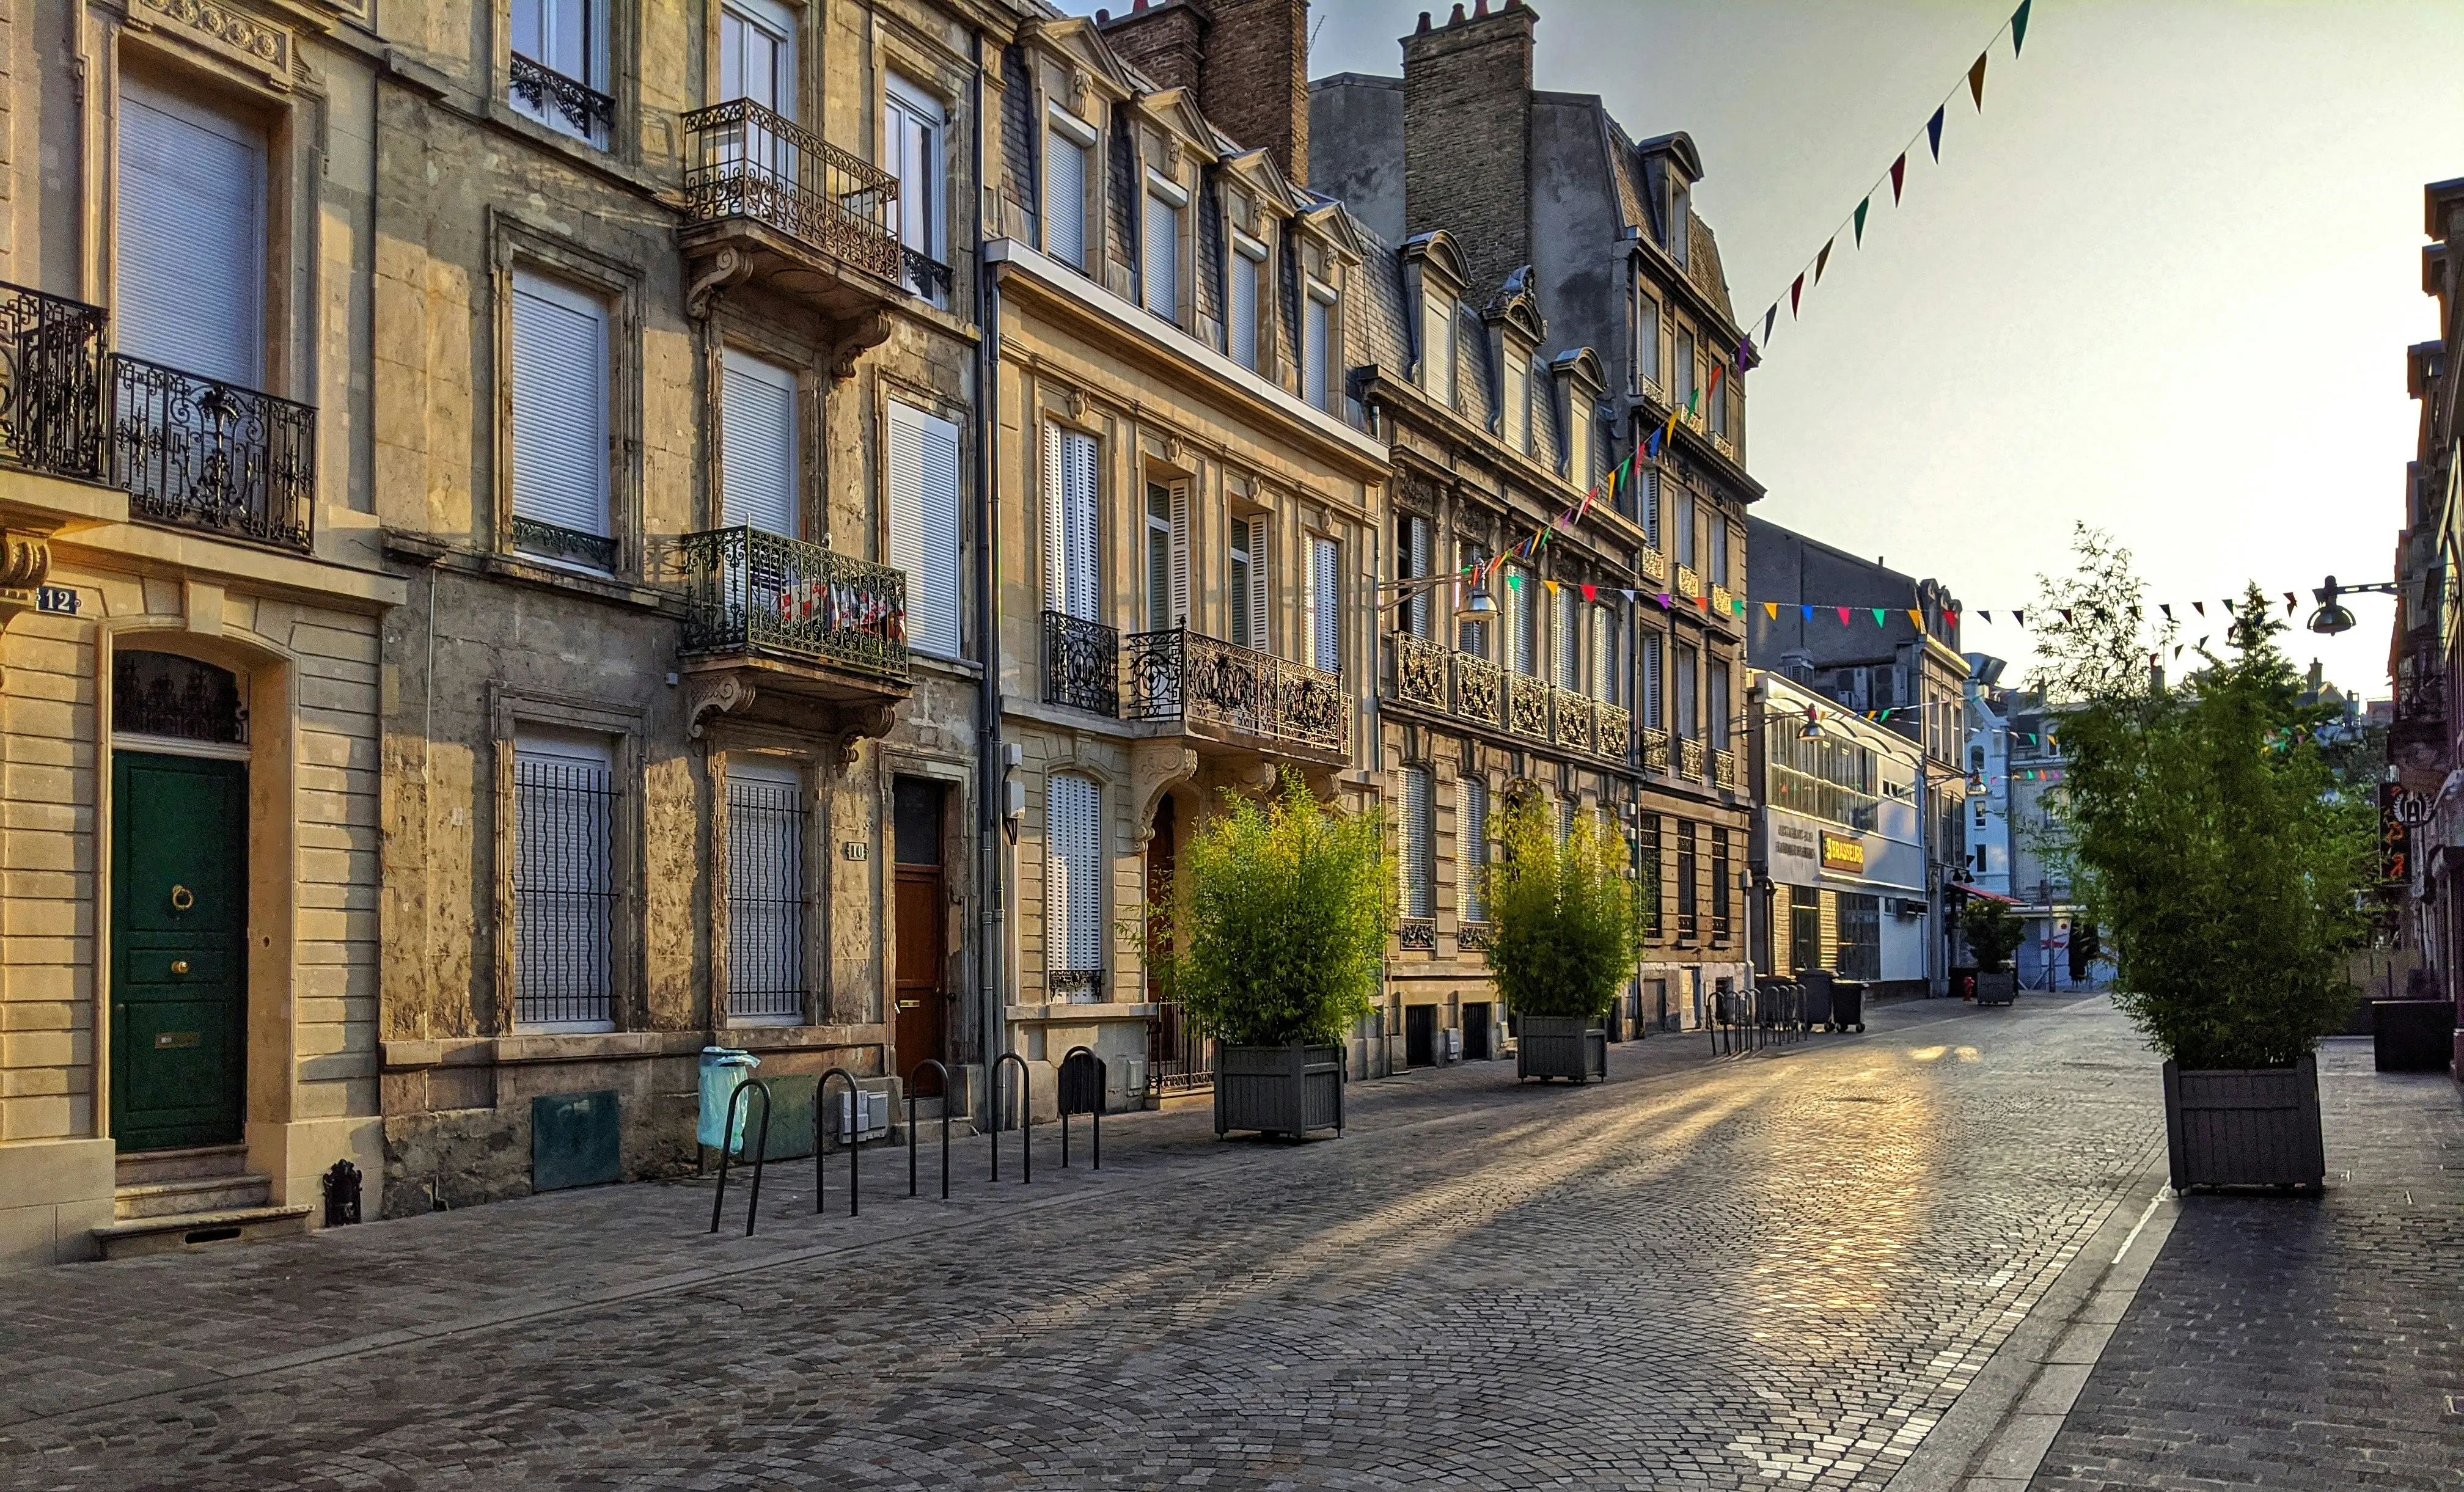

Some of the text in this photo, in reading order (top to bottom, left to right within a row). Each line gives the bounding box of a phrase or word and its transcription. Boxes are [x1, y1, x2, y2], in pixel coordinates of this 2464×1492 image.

[46, 589, 70, 610] 12
[851, 845, 864, 858] 10
[1832, 840, 1863, 863] BRASSEURS
